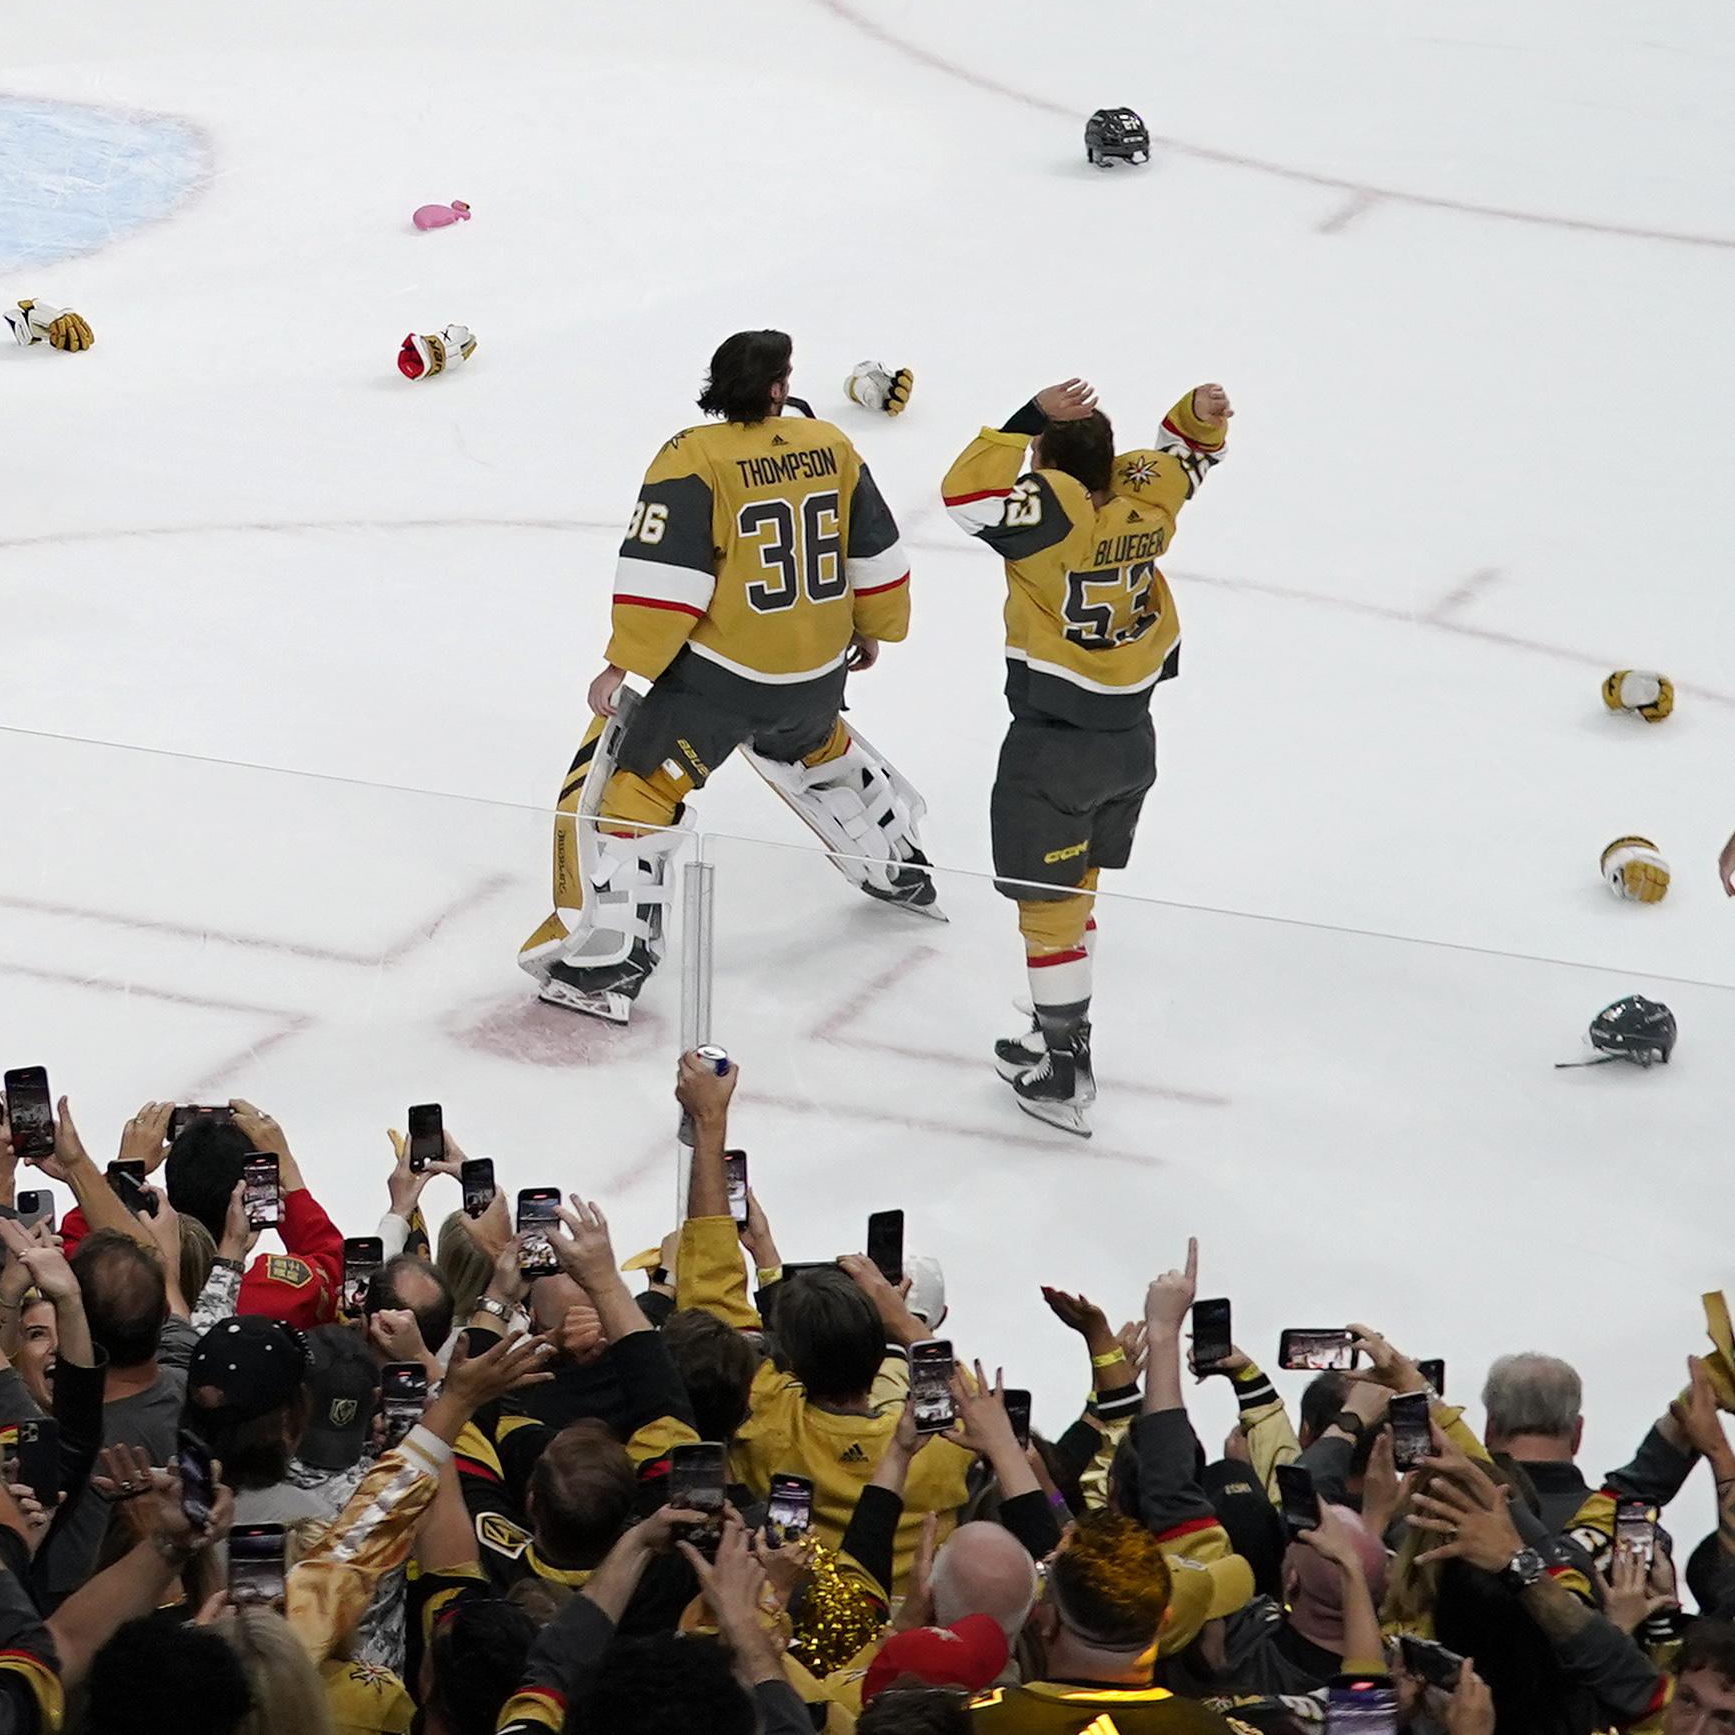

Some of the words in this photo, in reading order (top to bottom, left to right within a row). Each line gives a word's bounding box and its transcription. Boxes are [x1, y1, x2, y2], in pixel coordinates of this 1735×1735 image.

[736, 447, 838, 489] THOMPSON
[736, 488, 849, 615] 36
[1094, 528, 1165, 567] BLUEGER
[1061, 561, 1161, 652] 53
